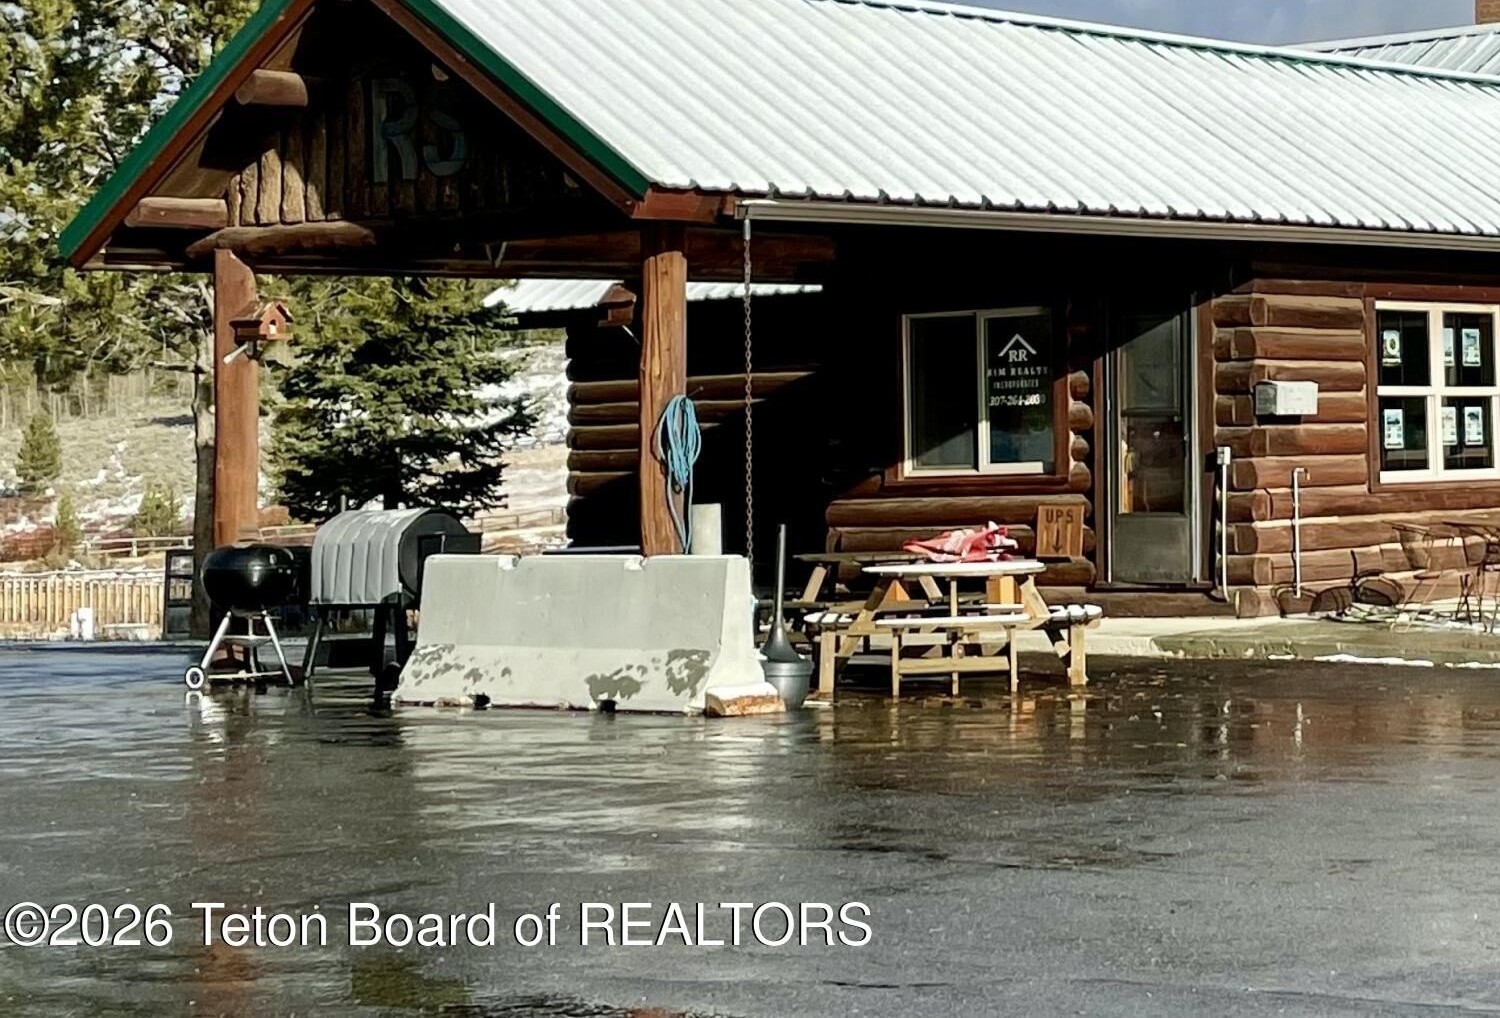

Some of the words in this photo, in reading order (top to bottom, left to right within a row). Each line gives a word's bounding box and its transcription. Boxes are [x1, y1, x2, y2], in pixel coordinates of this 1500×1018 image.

[1008, 349, 1028, 362] RR
[1010, 366, 1048, 376] REALTY
[1045, 508, 1074, 523] UPS
